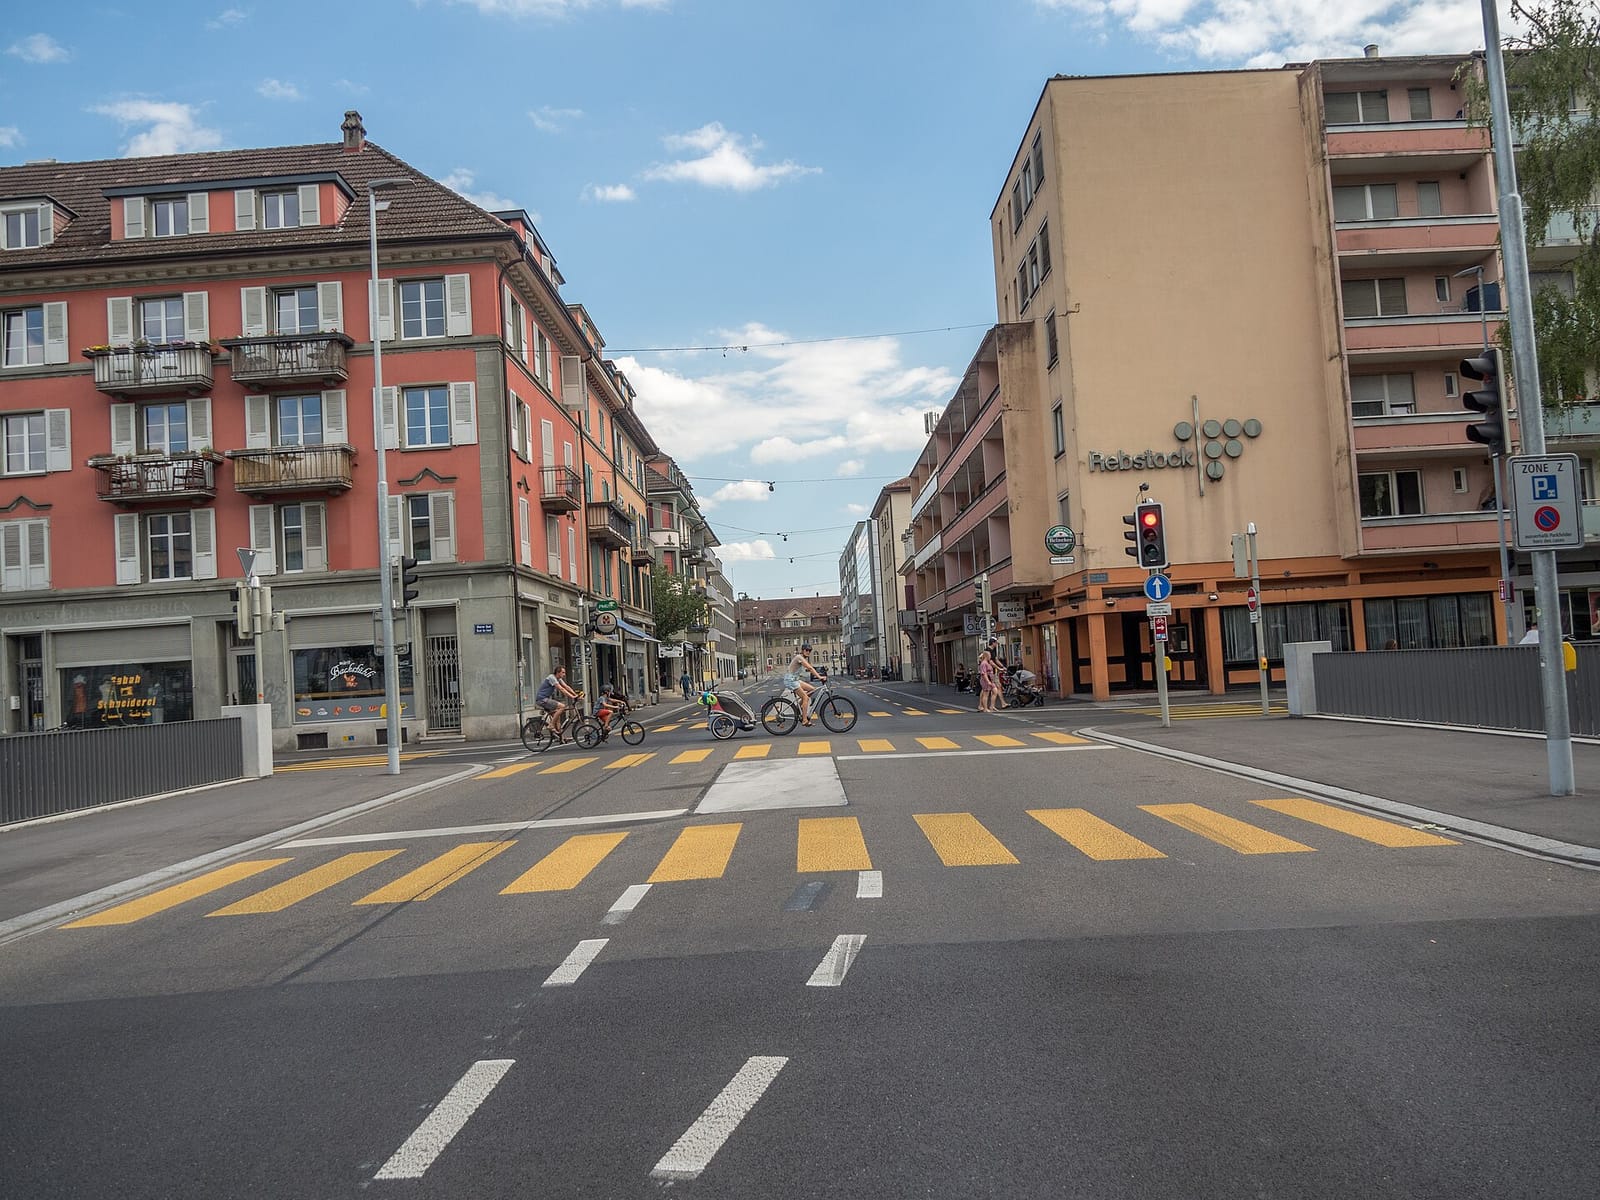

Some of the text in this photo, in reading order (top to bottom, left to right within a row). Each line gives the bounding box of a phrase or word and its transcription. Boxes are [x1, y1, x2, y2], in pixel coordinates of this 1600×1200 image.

[1088, 447, 1194, 472] Rebstock
[1522, 463, 1564, 473] ZONE Z
